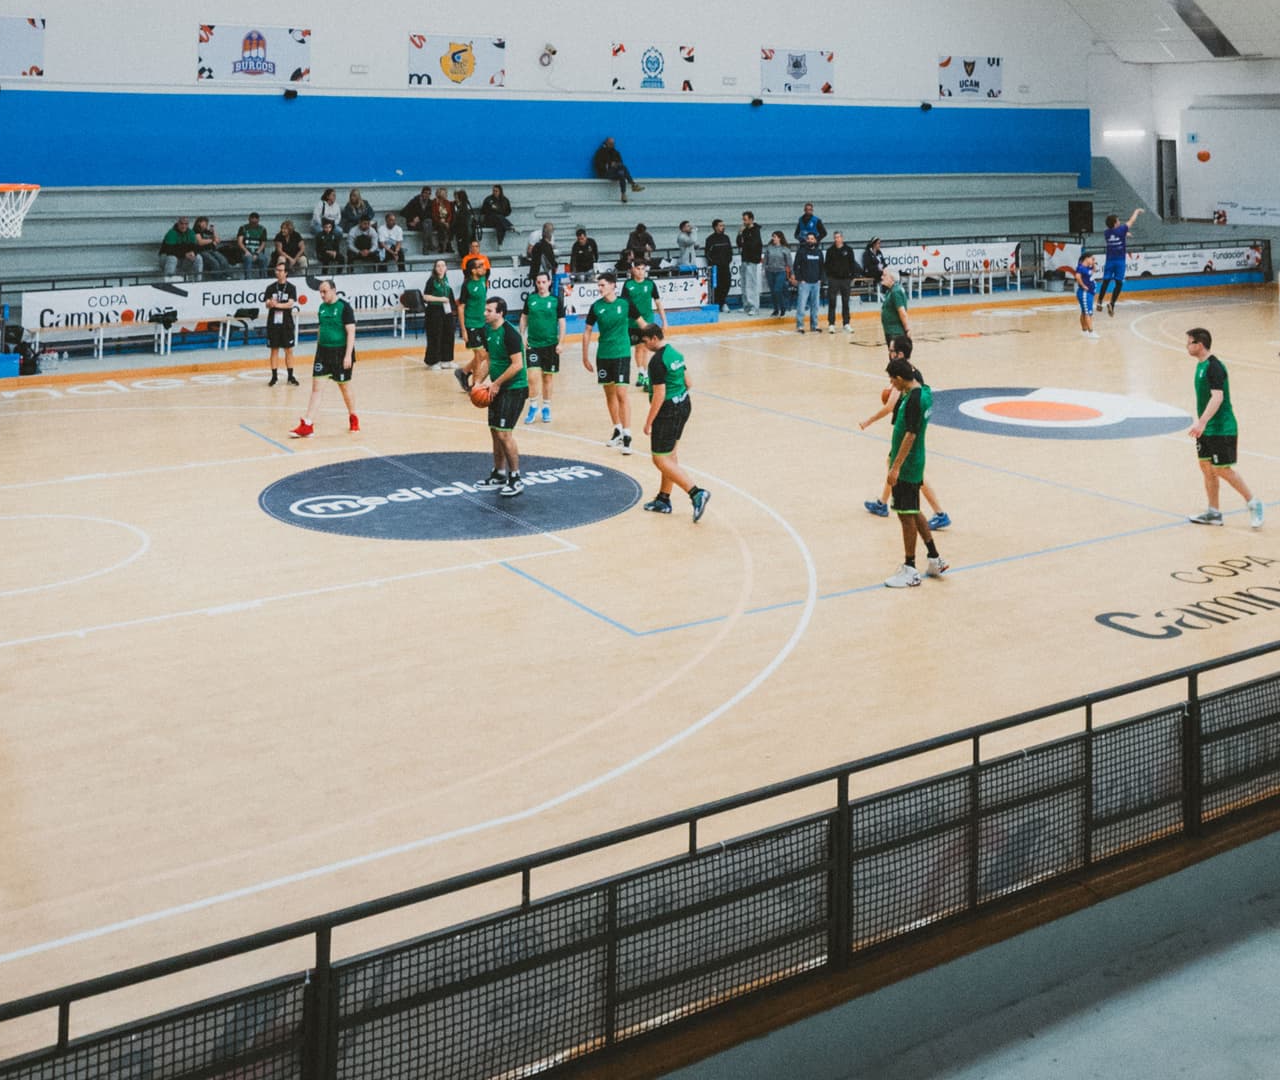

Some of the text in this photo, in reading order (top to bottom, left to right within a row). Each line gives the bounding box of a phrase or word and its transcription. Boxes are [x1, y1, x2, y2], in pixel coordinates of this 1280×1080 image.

[235, 60, 274, 73] BURGOS
[959, 79, 980, 89] UCAM
[373, 279, 406, 292] COPA
[88, 293, 129, 308] COPA
